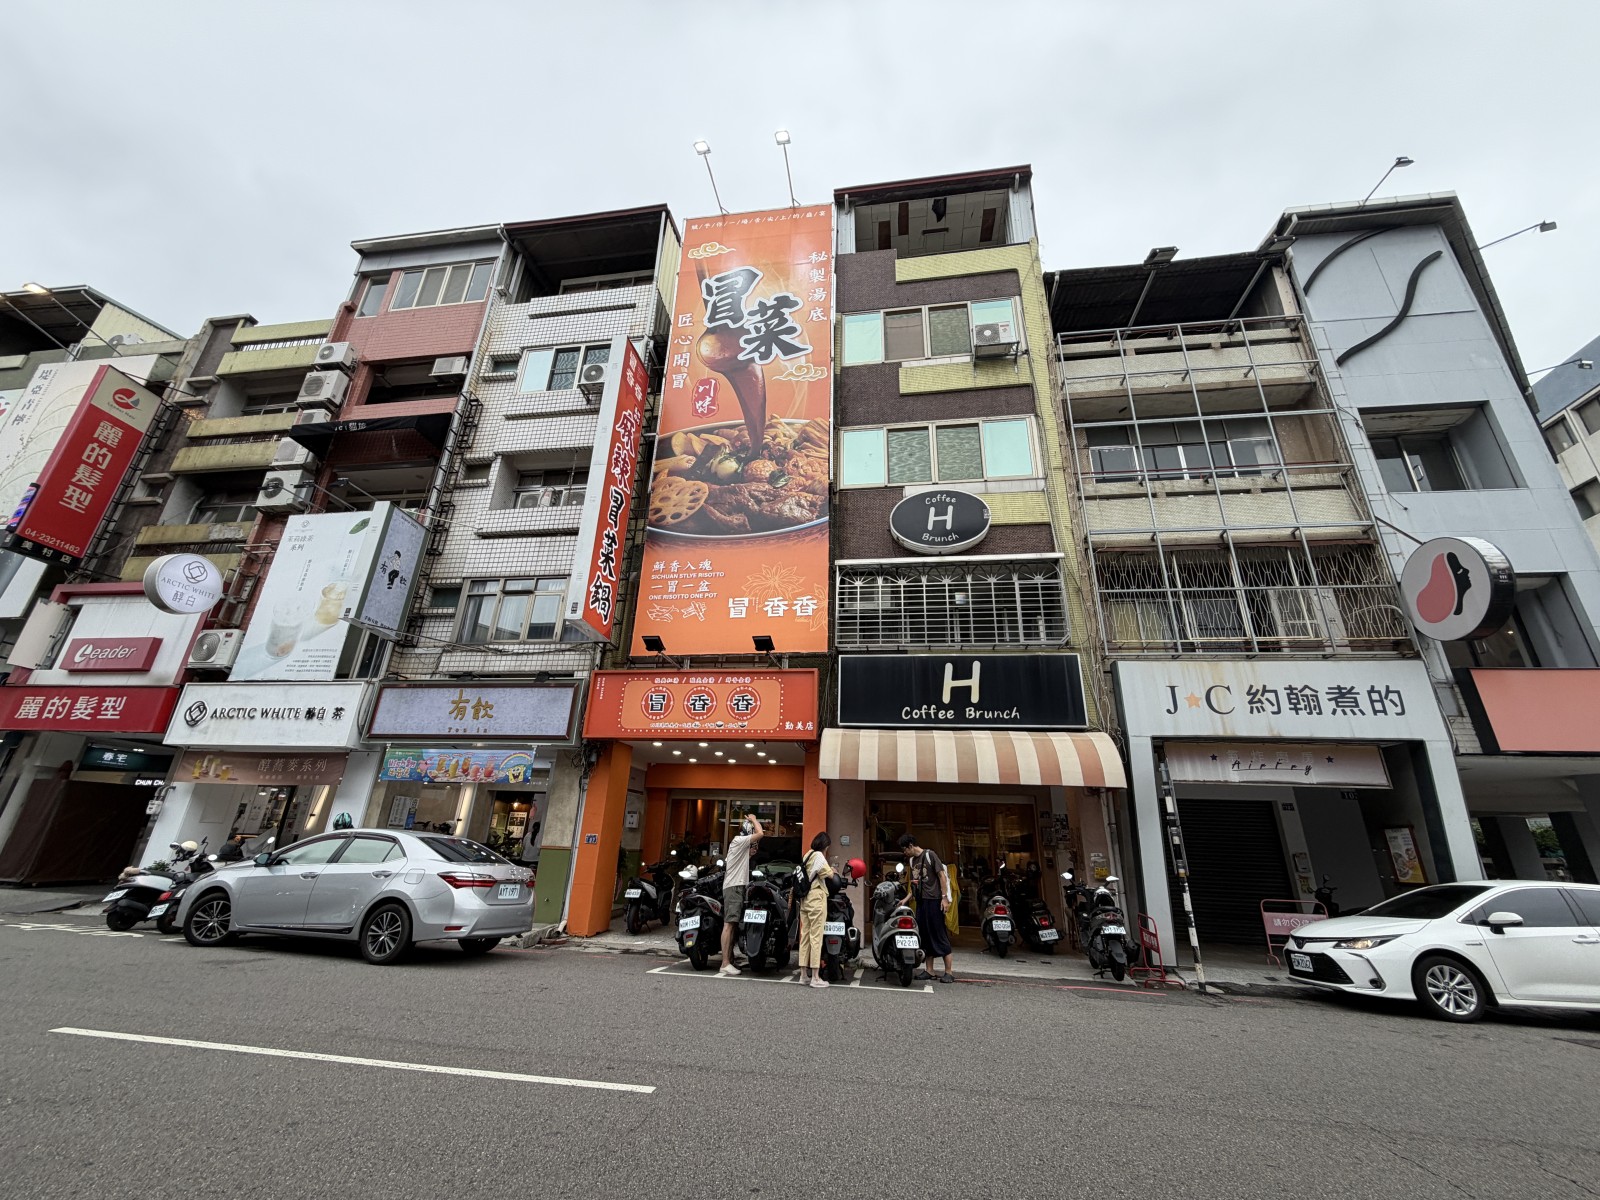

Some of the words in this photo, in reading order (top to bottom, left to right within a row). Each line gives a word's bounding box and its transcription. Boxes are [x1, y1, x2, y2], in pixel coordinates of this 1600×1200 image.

[807, 251, 828, 323] 秘製湯底
[702, 266, 812, 364] 冒菜
[672, 312, 694, 389] 匠心開冒
[695, 380, 716, 414] 川味
[59, 420, 125, 514] 麗的髮型
[925, 494, 956, 505] Coffee
[589, 410, 635, 625] 麻辣冒菜鍋
[927, 505, 953, 531] H
[25, 528, 80, 554] 04-23211462
[922, 532, 959, 542] Brunch
[652, 558, 713, 573] 鮮香入魂
[161, 577, 190, 591] ARCTIC
[192, 587, 216, 600] WHITE
[651, 580, 711, 593] 一冒一盆
[74, 643, 137, 663] Leader
[942, 660, 981, 704] H
[14, 696, 127, 720] 麗的髮型
[210, 707, 257, 719] ARCTIC
[260, 707, 301, 719] WHITE
[449, 689, 494, 720] 有飲
[902, 706, 955, 720] Coffee
[966, 707, 1020, 720] Brunch
[1246, 684, 1406, 717] 約翰煮的
[785, 721, 813, 730] 勤美店
